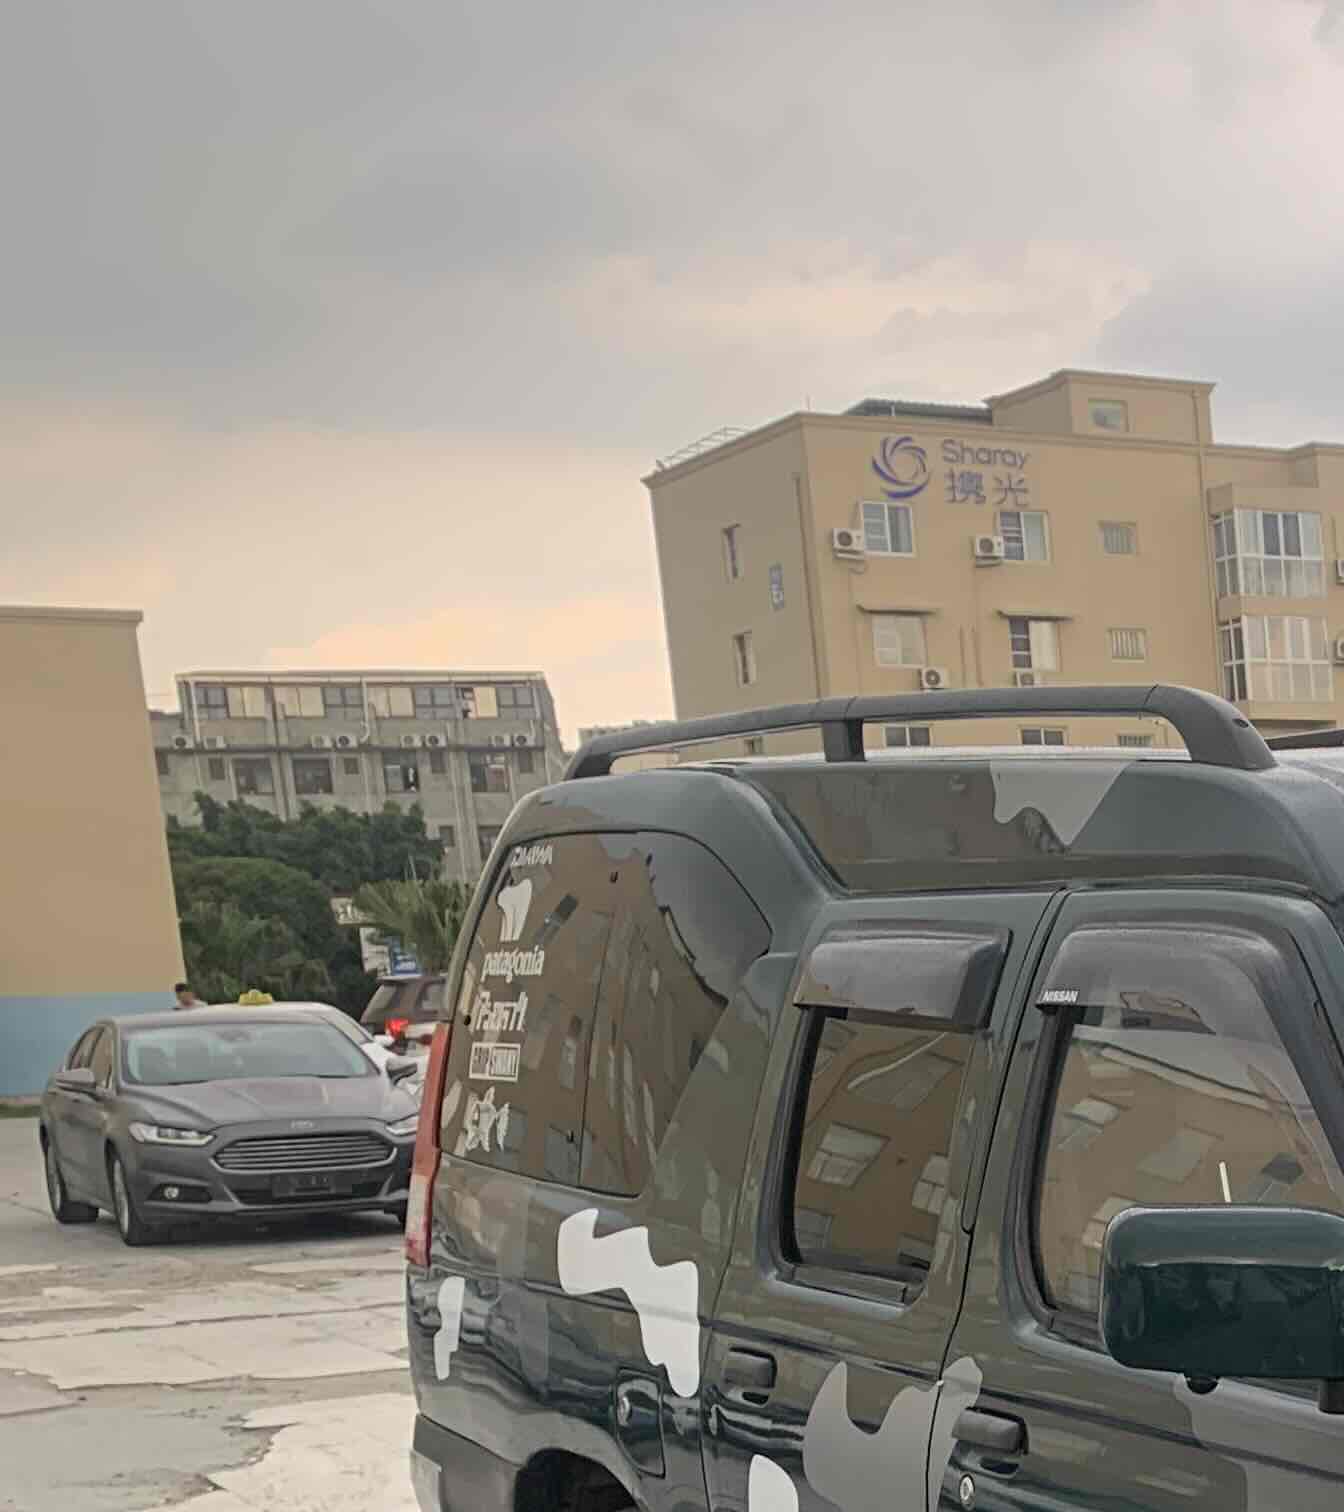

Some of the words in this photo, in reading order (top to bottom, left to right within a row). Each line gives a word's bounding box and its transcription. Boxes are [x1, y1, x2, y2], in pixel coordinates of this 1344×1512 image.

[942, 438, 1030, 469] Sharay
[481, 945, 545, 984] patagonia
[1041, 990, 1080, 1003] NISSAN
